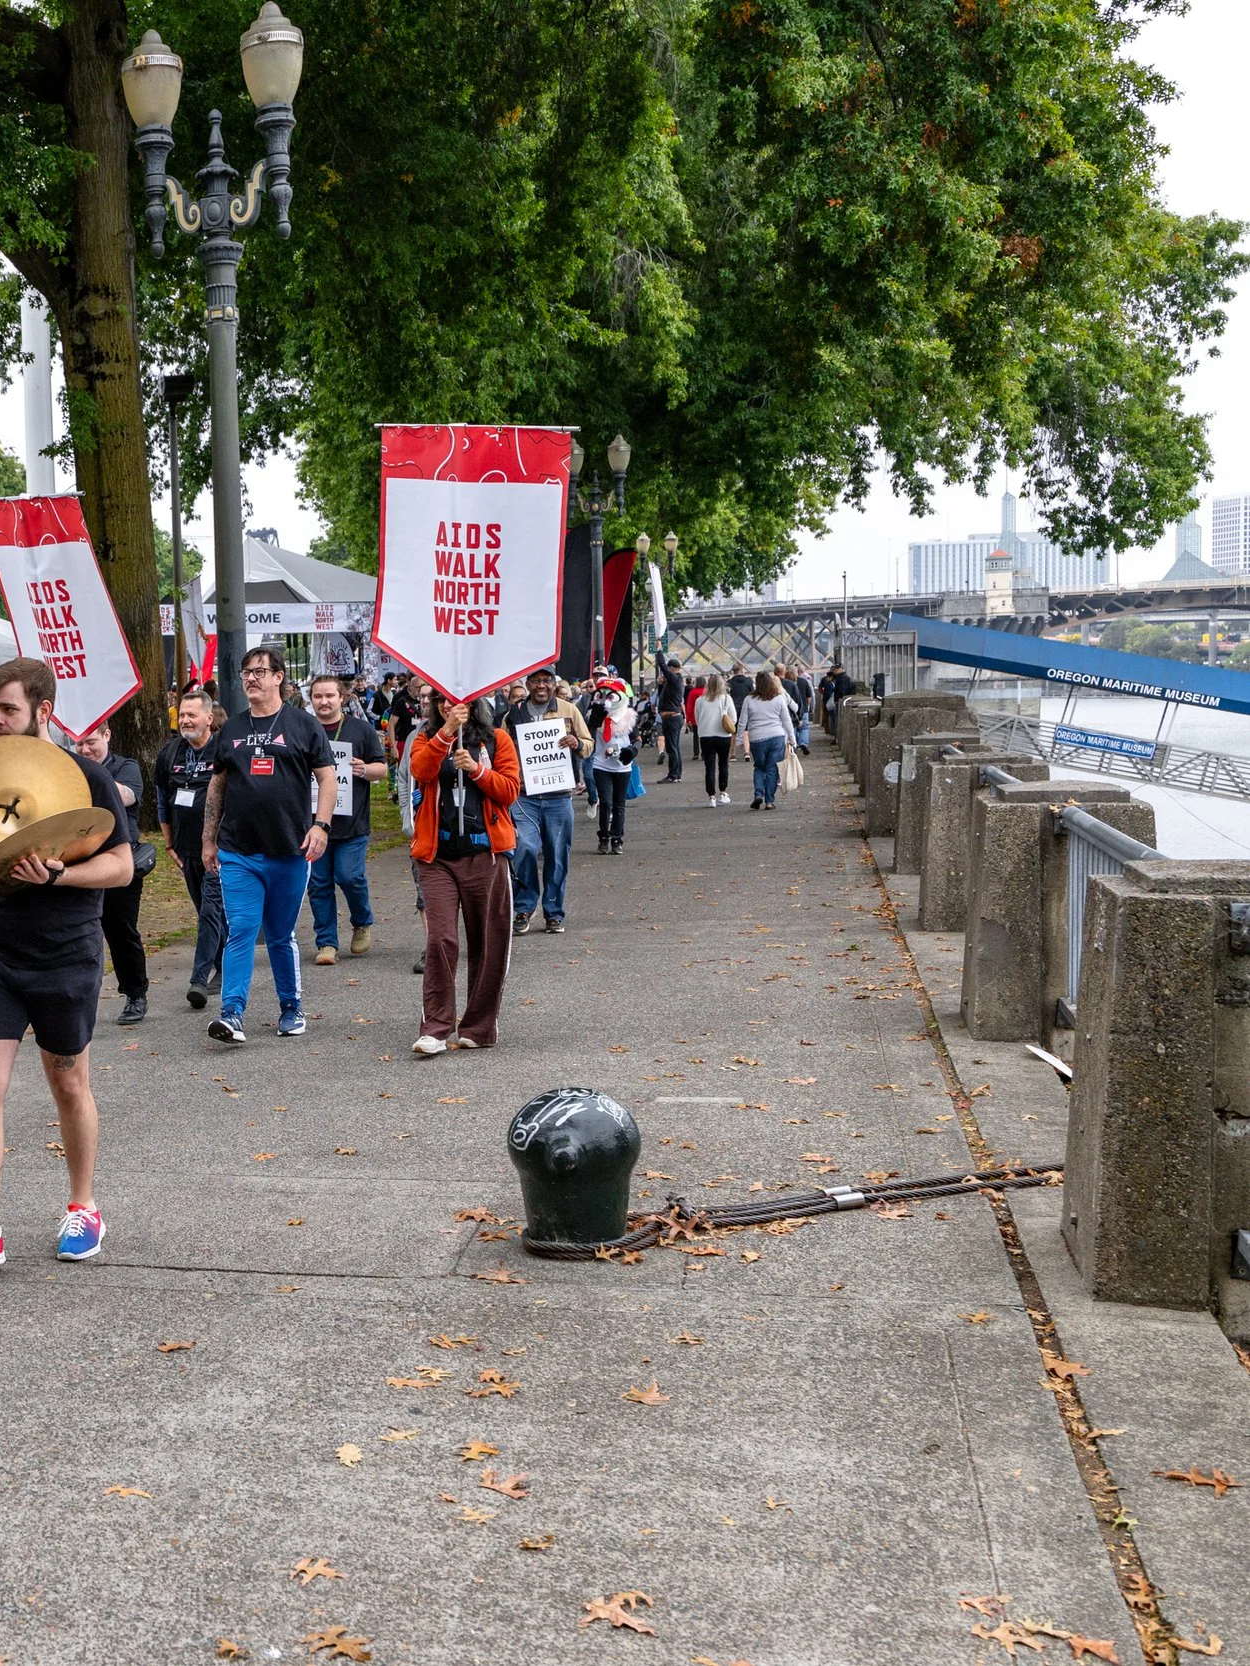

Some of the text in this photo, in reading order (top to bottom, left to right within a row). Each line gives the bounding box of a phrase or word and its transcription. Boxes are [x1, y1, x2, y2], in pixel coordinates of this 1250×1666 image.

[435, 521, 501, 549] AIDS
[435, 550, 501, 579] WALK
[434, 579, 500, 605] NORTH
[207, 613, 281, 624] WOME
[434, 606, 499, 636] WEST
[1047, 668, 1221, 707] OREGON MARITIME MUSEUM
[524, 728, 560, 741] STOMP
[533, 741, 555, 751] OUT
[1056, 729, 1154, 756] OREGON MARITIME MUSEUM
[525, 752, 567, 765] STIGMA
[540, 774, 566, 786] LIFE
